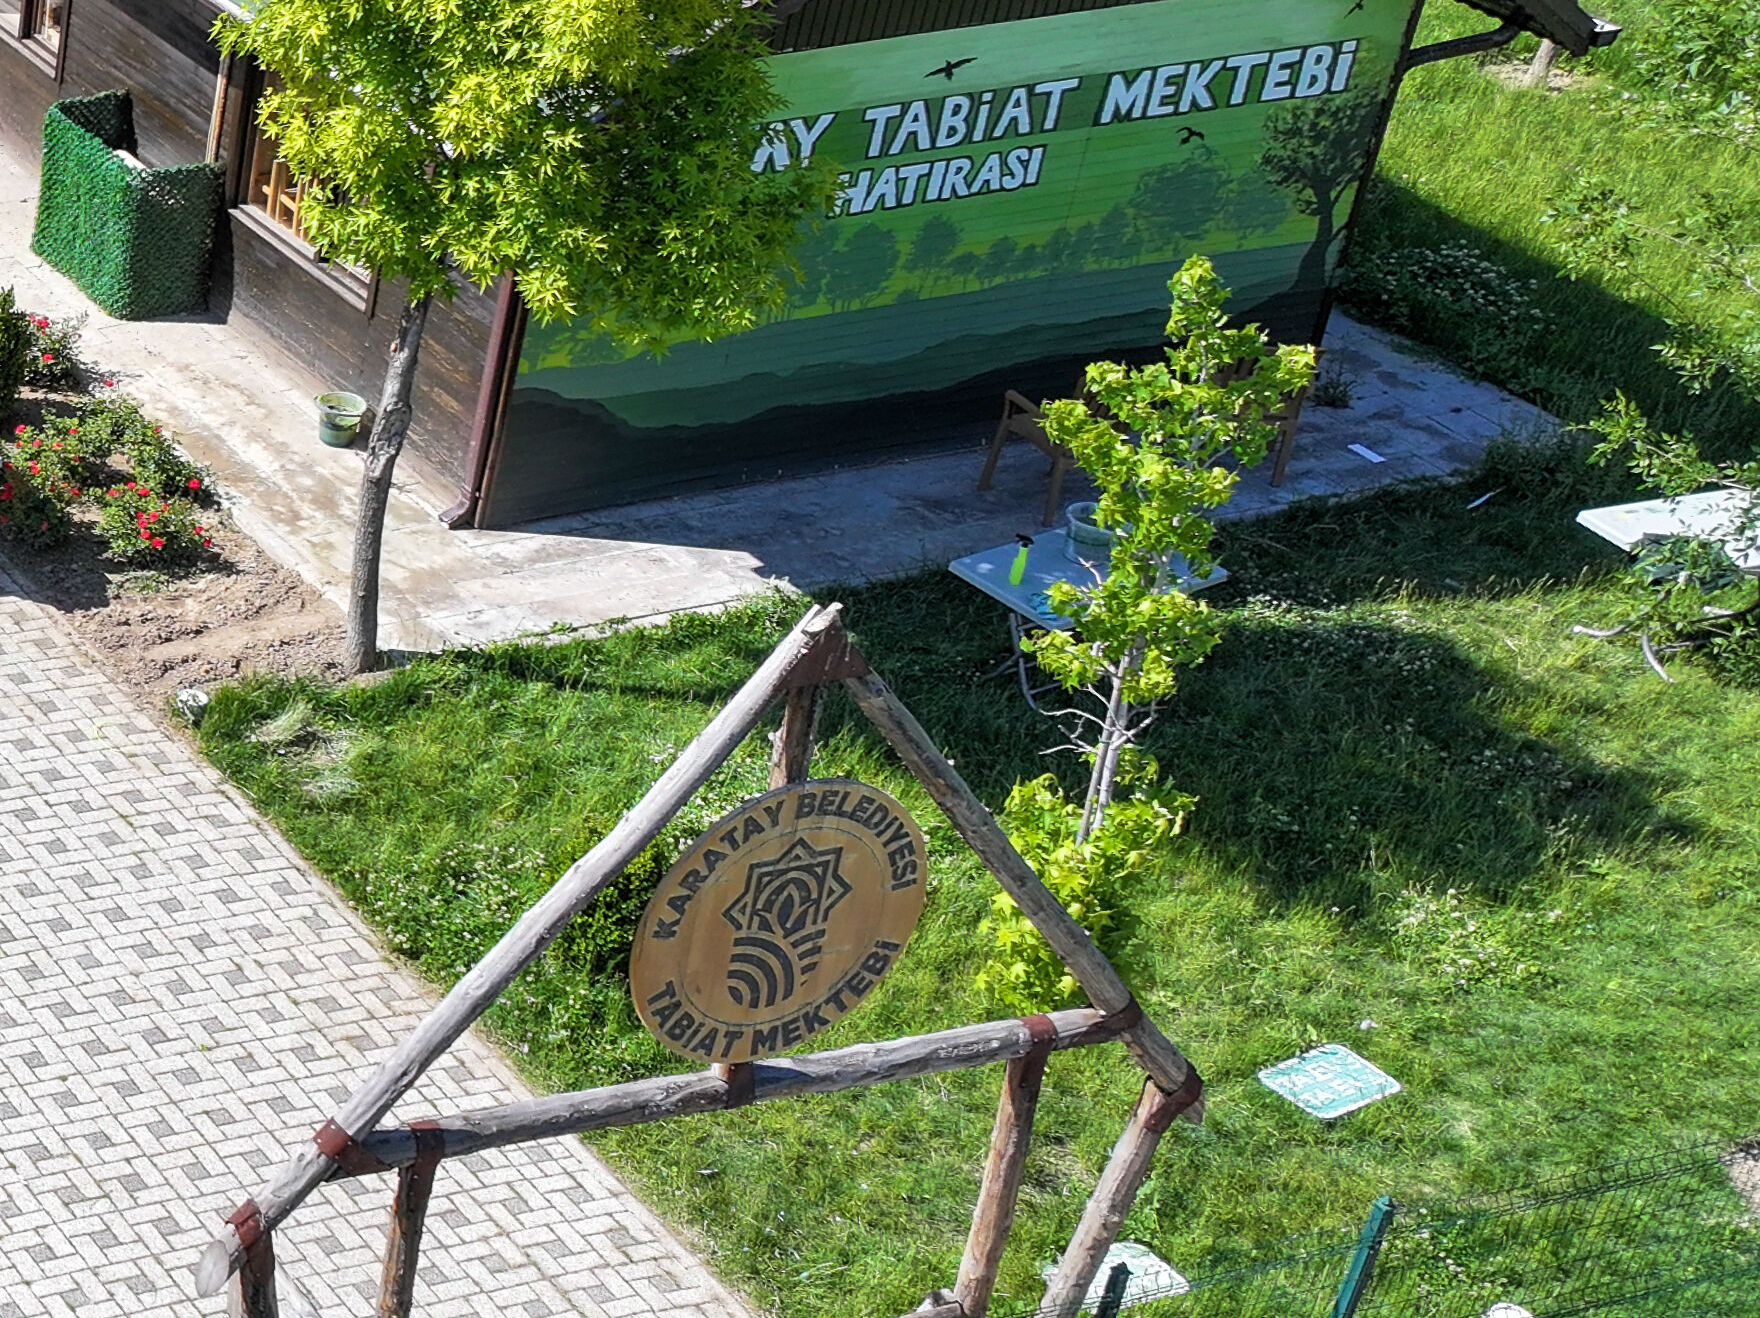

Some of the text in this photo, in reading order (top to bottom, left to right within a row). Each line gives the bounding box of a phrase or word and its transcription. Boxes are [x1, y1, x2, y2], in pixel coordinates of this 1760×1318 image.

[866, 78, 1080, 158] TABİAT
[1101, 39, 1359, 124] MEKTEBİ
[829, 146, 1046, 217] HATIRASI
[651, 799, 786, 939] KARATAY
[646, 980, 745, 1059] TABİAT
